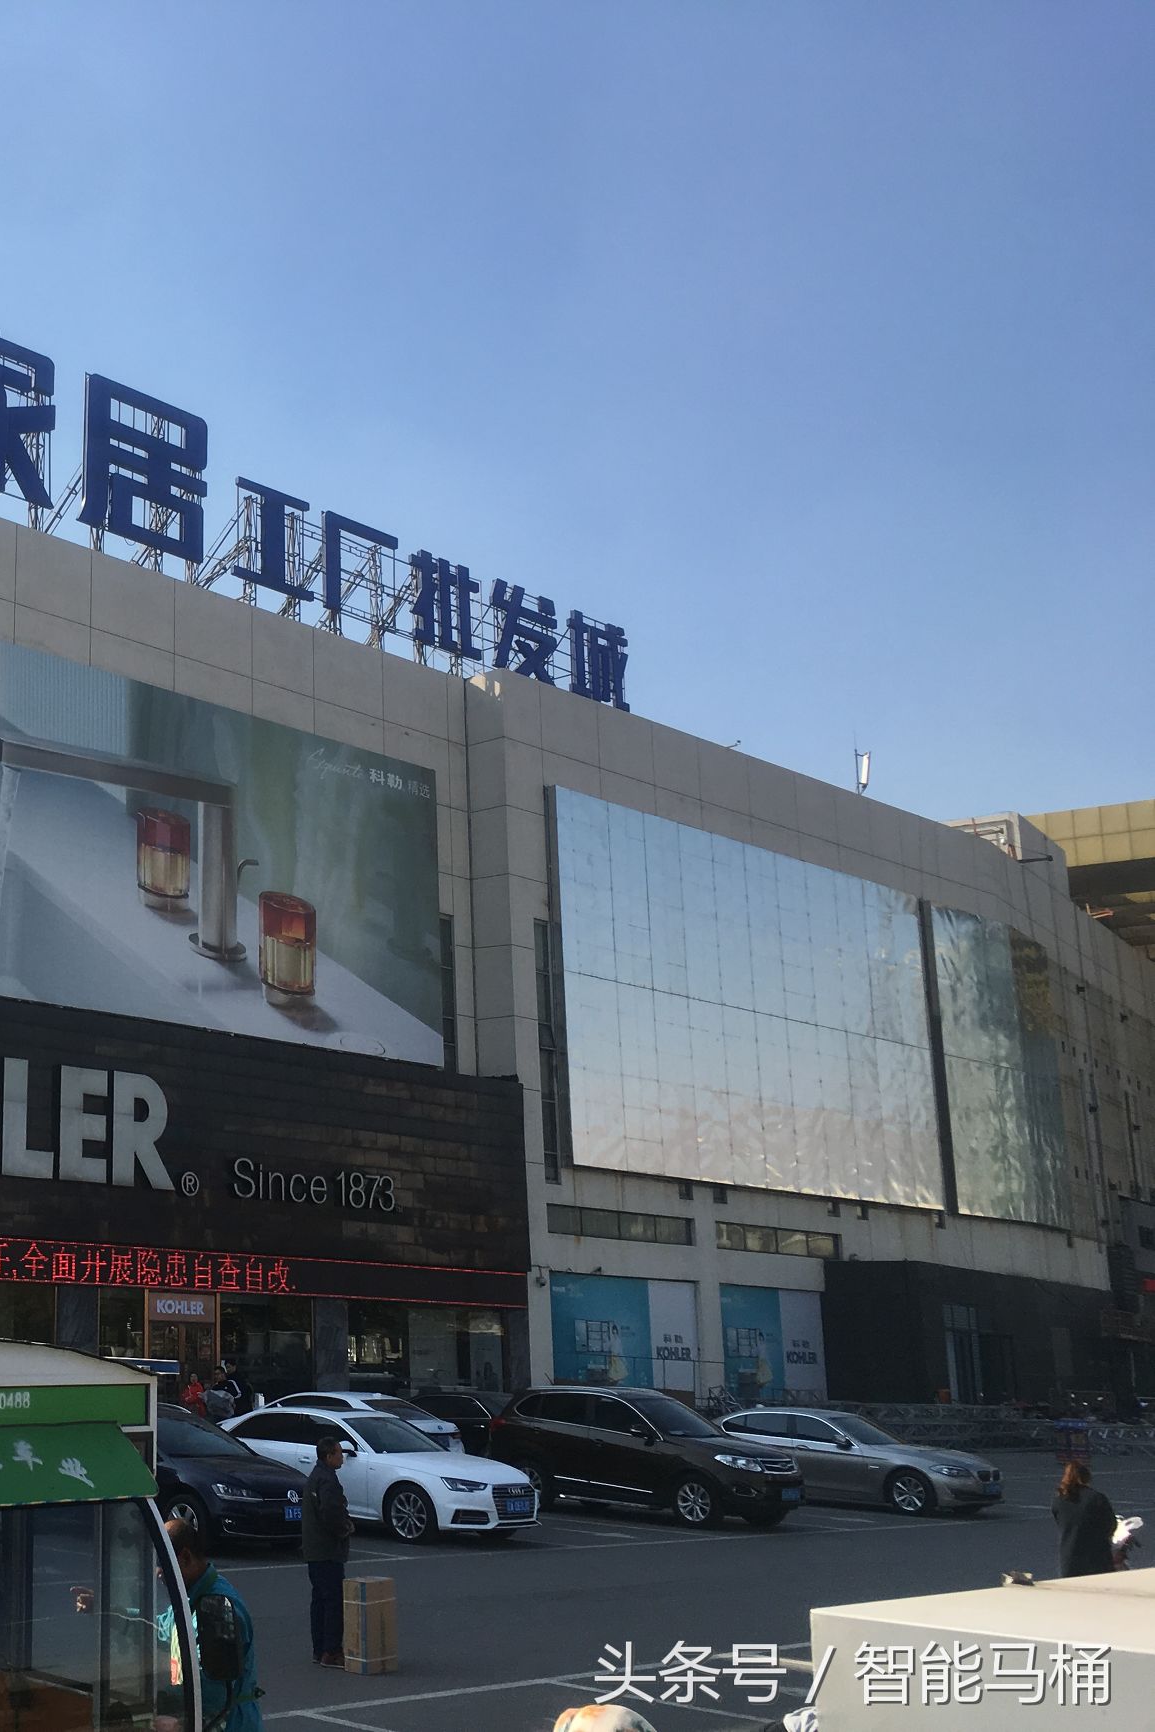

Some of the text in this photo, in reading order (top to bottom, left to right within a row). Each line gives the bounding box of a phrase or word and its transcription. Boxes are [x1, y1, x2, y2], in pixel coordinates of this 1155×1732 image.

[233, 1157, 396, 1212] Since 1873
[156, 1299, 205, 1317] KOHLER
[656, 1346, 692, 1361] KOHLER
[786, 1351, 818, 1365] KOHLER
